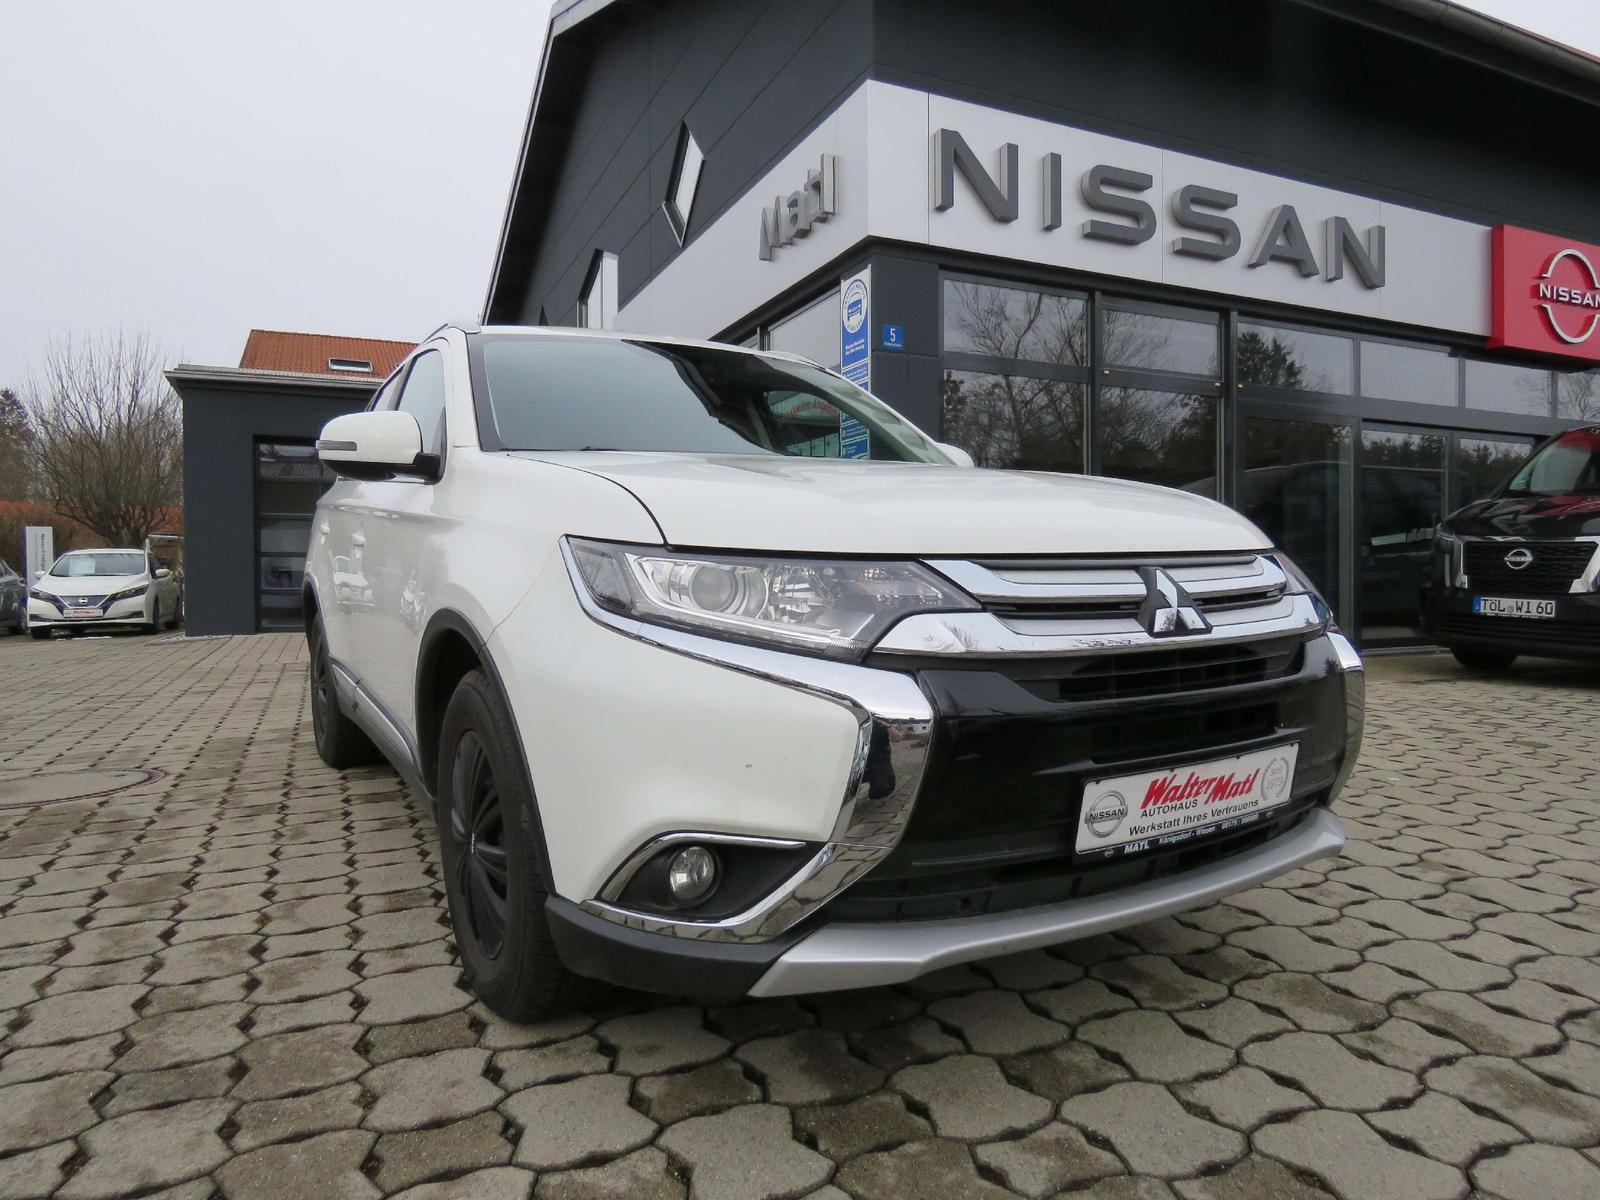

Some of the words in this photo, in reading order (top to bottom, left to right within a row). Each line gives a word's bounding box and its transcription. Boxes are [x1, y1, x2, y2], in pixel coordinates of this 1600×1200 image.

[934, 128, 1386, 289] NISSAN
[889, 328, 896, 342] 5
[1481, 599, 1505, 612] TÖL
[1515, 601, 1532, 613] WI
[1536, 602, 1553, 615] 60
[1141, 771, 1218, 809] Walter
[1204, 768, 1260, 805] Matl
[1089, 808, 1125, 820] NISSAN
[1141, 799, 1198, 818] AUTOHAUS
[1129, 817, 1180, 836] Werkstatt
[1183, 812, 1208, 825] Ihres
[1211, 799, 1259, 817] Vertrauens
[1124, 840, 1150, 854] MATL
